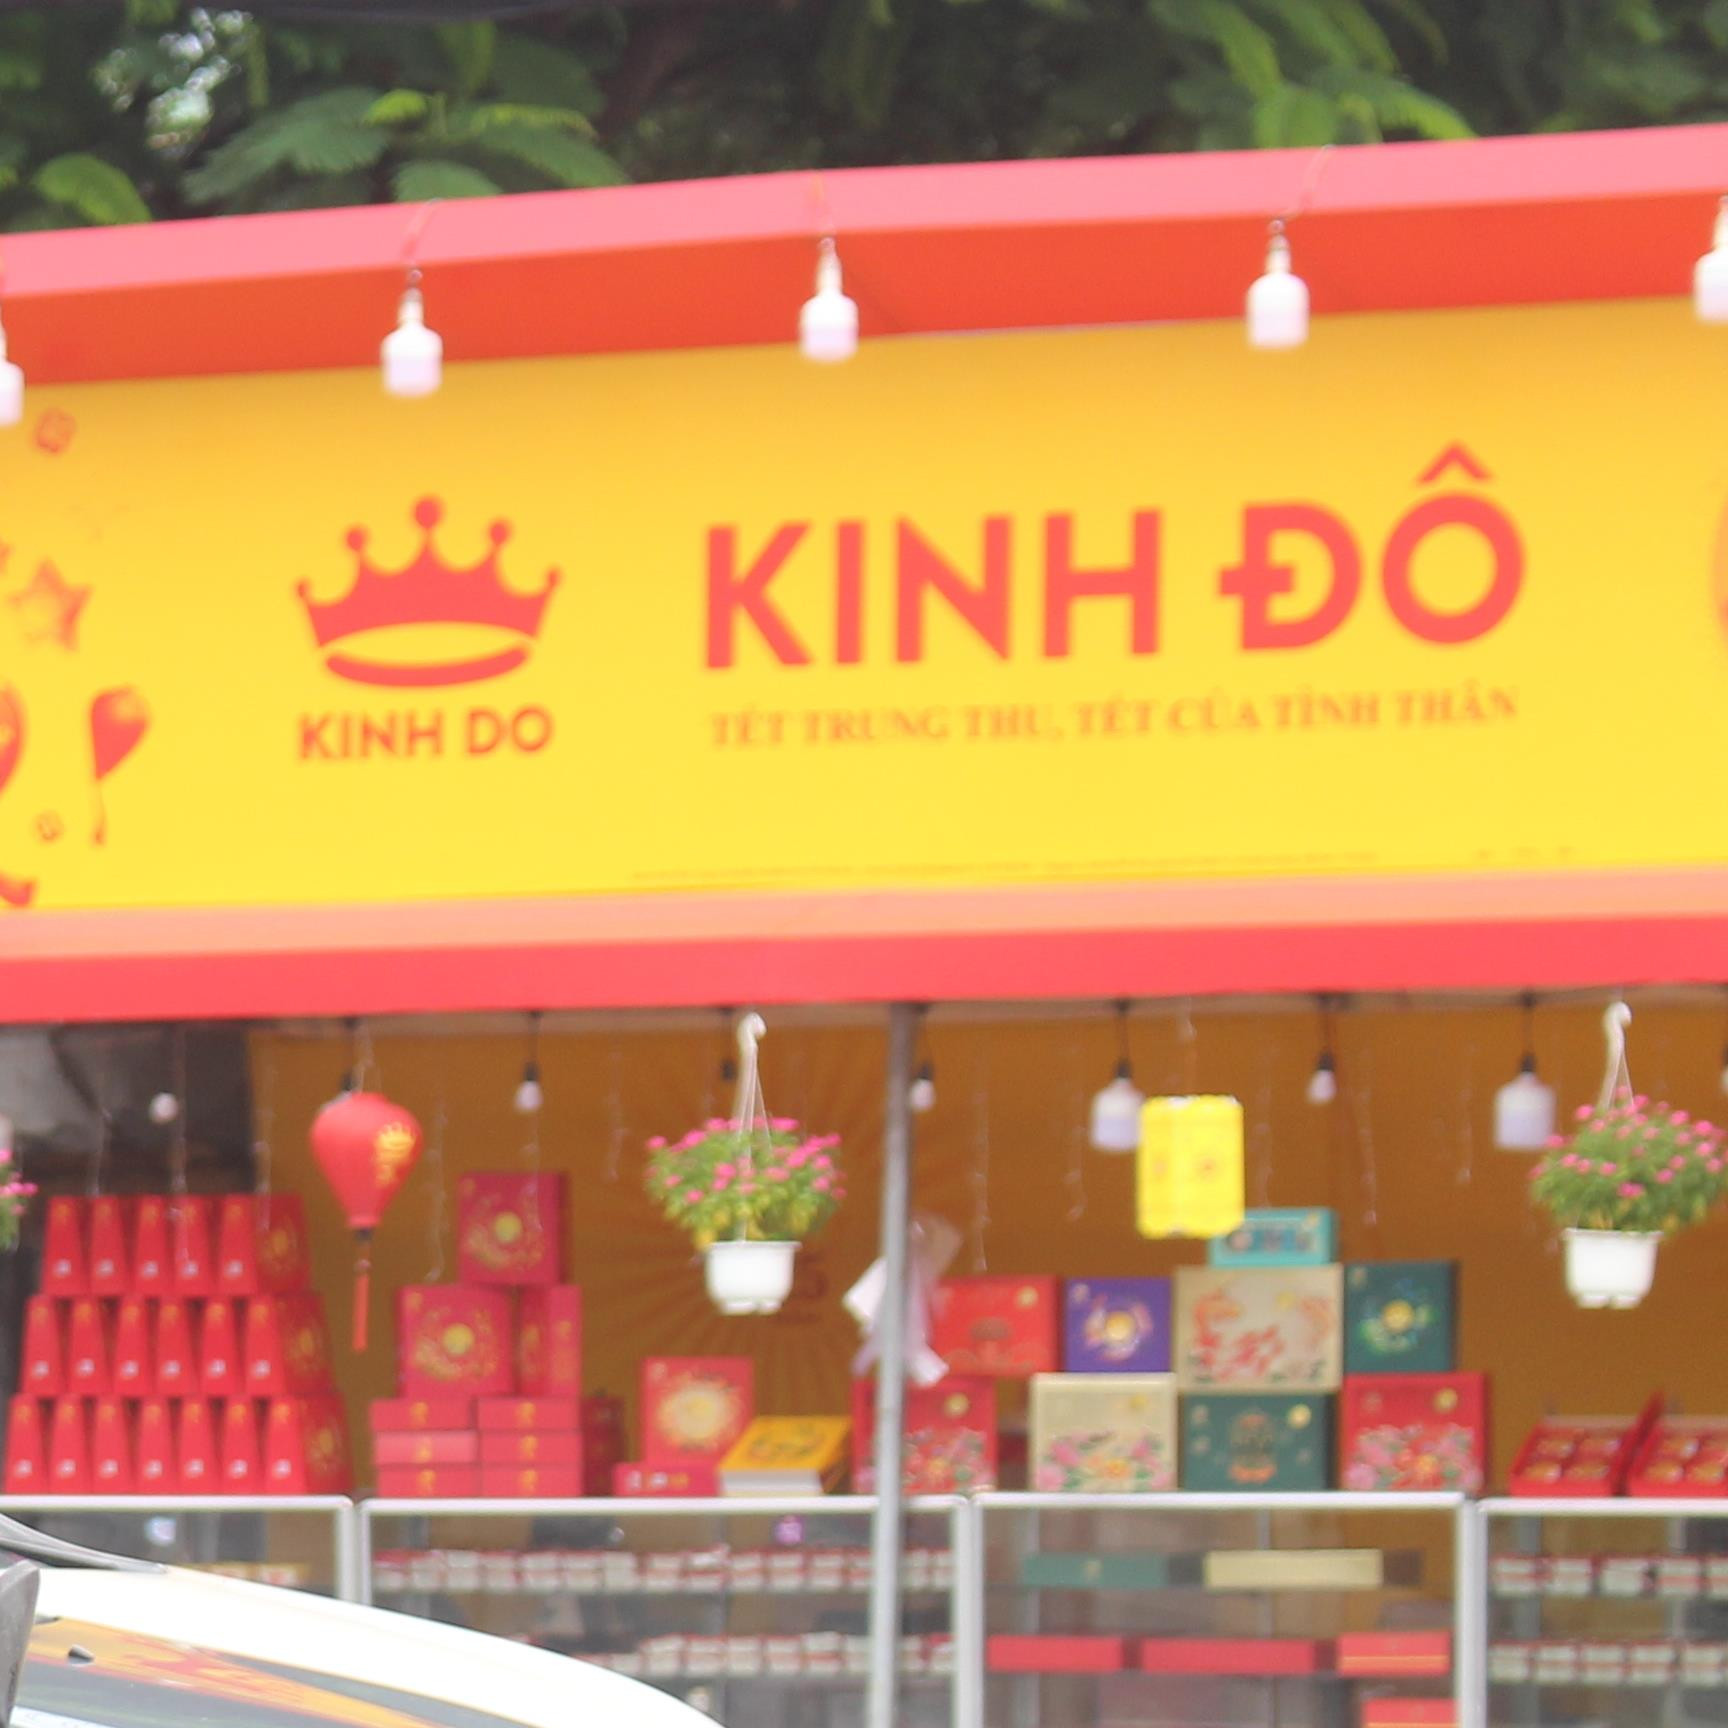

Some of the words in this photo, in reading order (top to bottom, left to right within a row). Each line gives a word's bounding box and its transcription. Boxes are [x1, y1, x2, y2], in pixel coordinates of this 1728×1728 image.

[700, 505, 1163, 671] KINH
[1216, 439, 1527, 651] ĐÔ
[297, 709, 446, 761] KINH
[466, 705, 555, 757] DO
[802, 704, 951, 747] TRUNG
